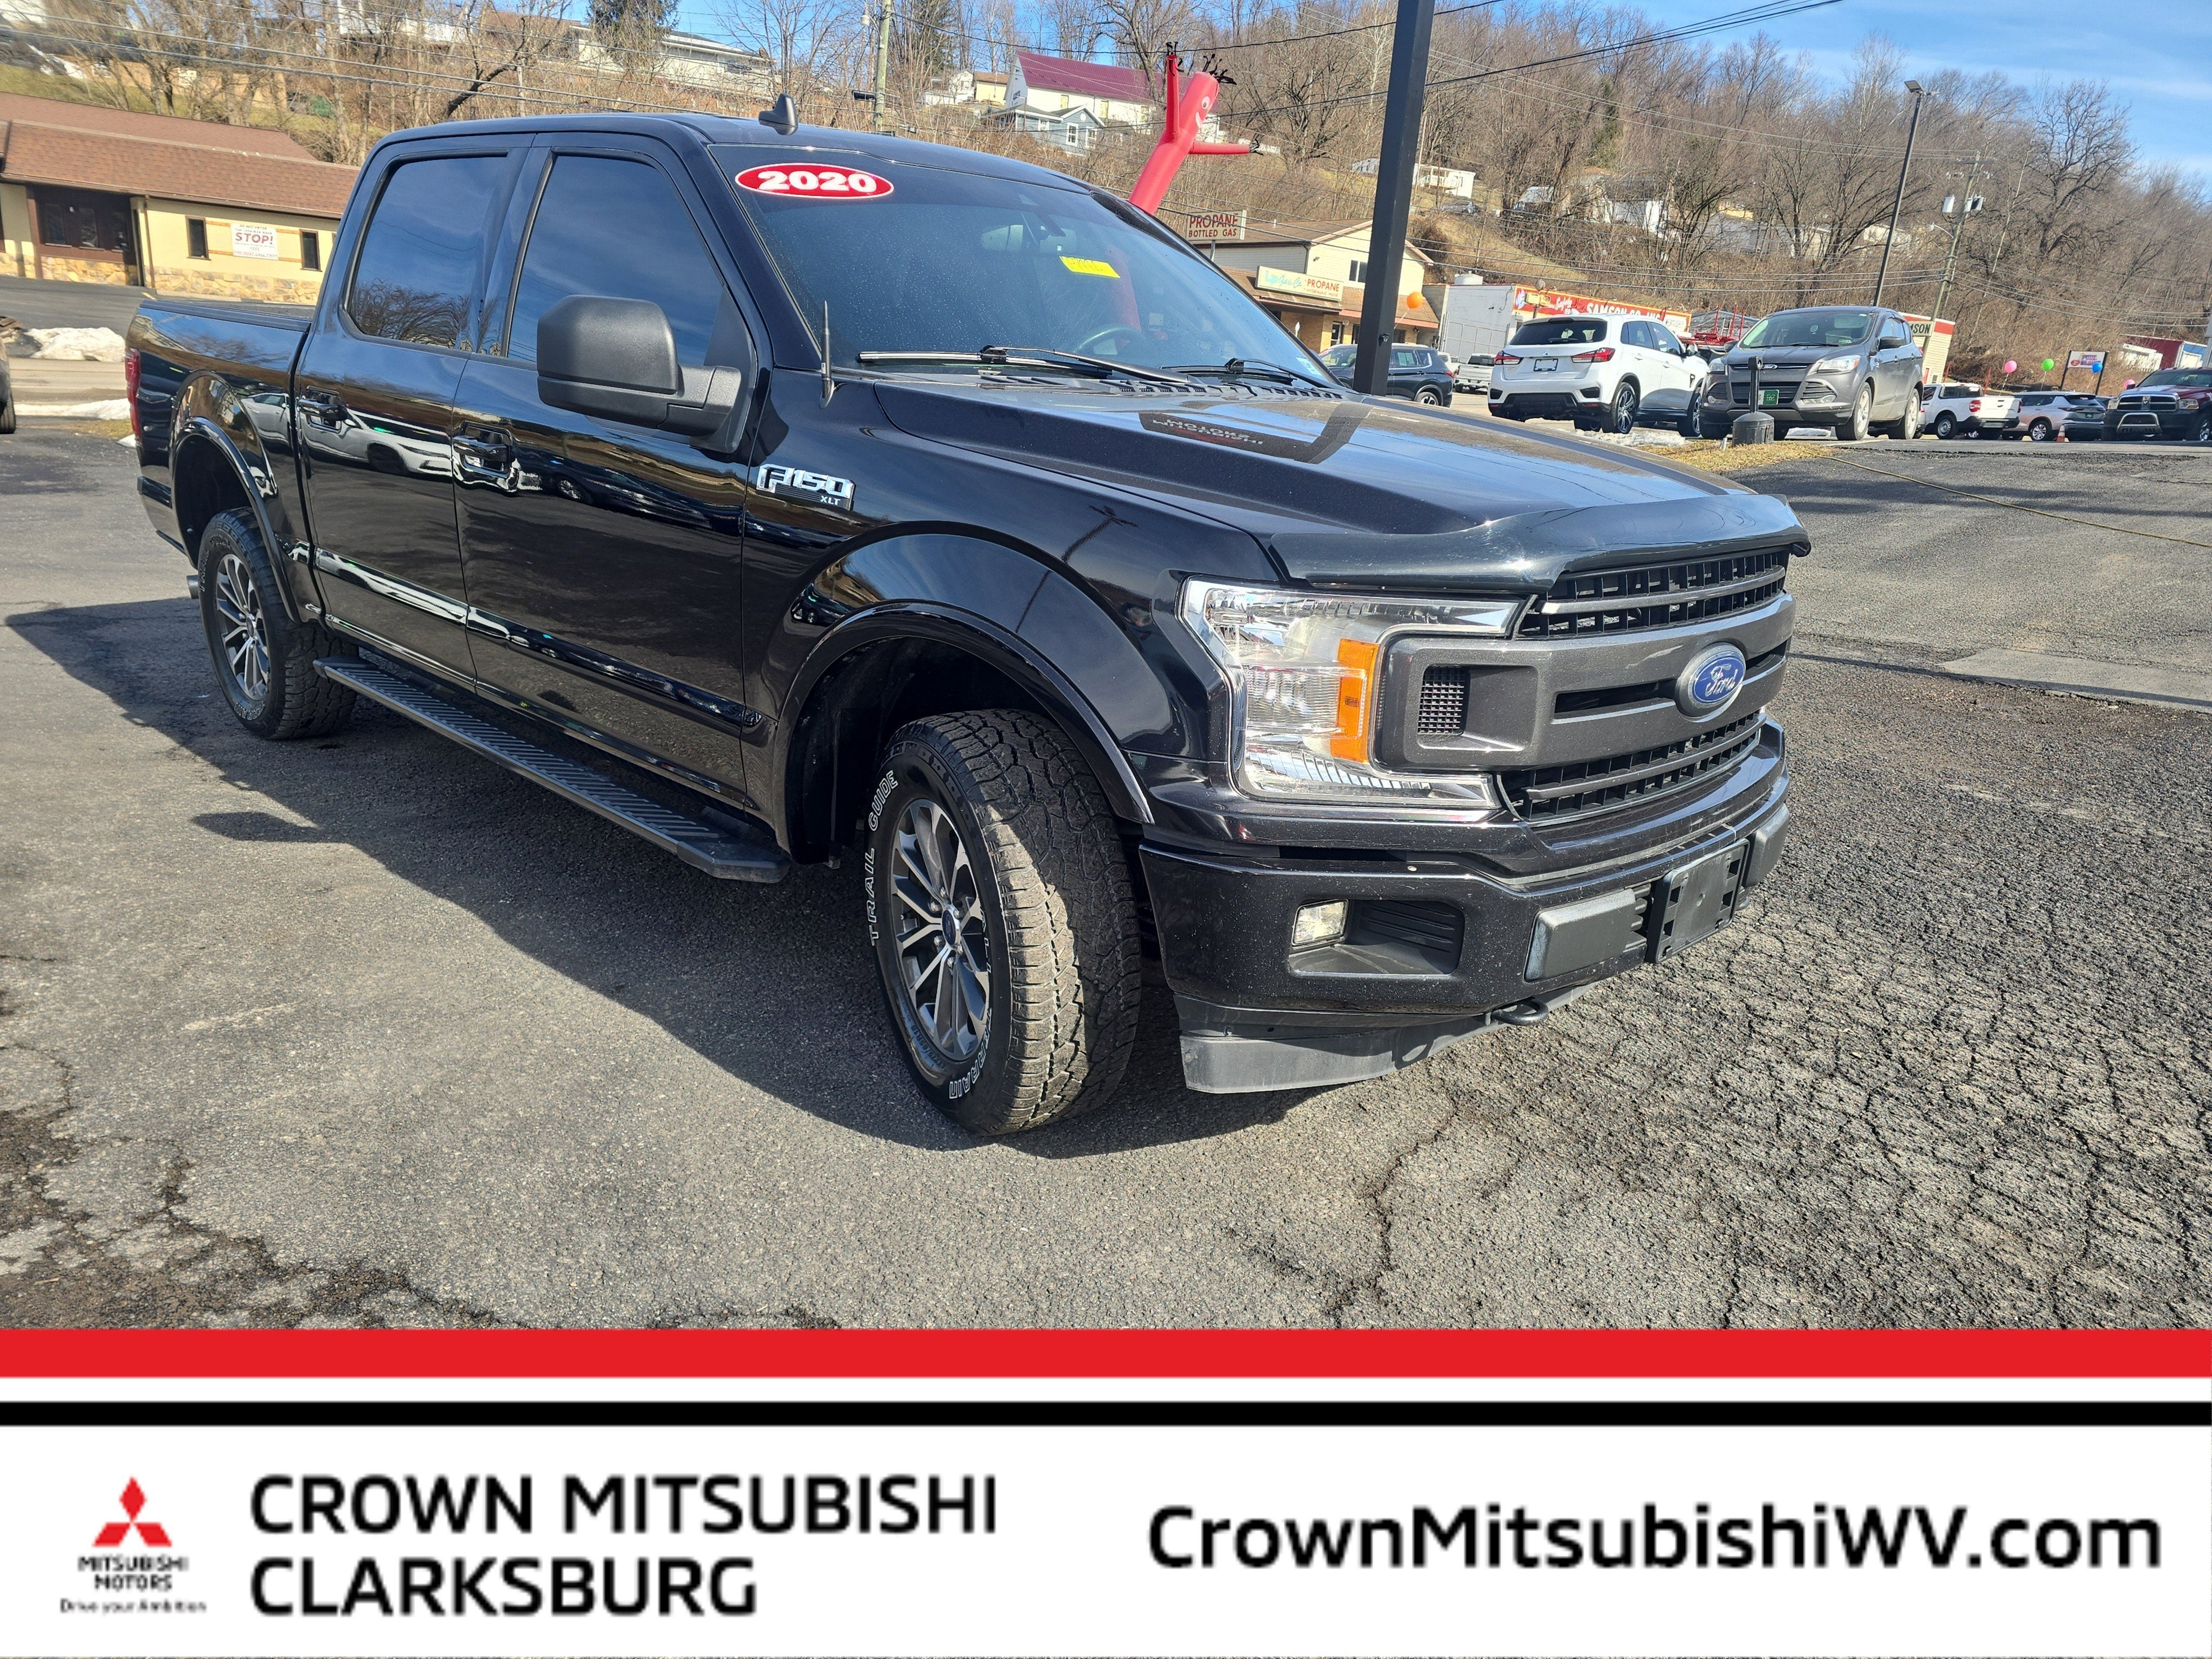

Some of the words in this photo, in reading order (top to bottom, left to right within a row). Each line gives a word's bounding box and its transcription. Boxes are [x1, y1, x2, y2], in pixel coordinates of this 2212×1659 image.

[757, 170, 877, 192] 2020
[1189, 213, 1238, 228] PROPANE
[235, 232, 273, 245] STOP!
[1188, 229, 1218, 237] BOTTLED
[1223, 228, 1237, 236] GAS
[1307, 279, 1340, 292] PROPANE
[820, 495, 841, 505] XLT
[1705, 664, 1738, 697] Ford
[868, 770, 898, 832] GUIDE
[865, 847, 879, 946] TRAIL
